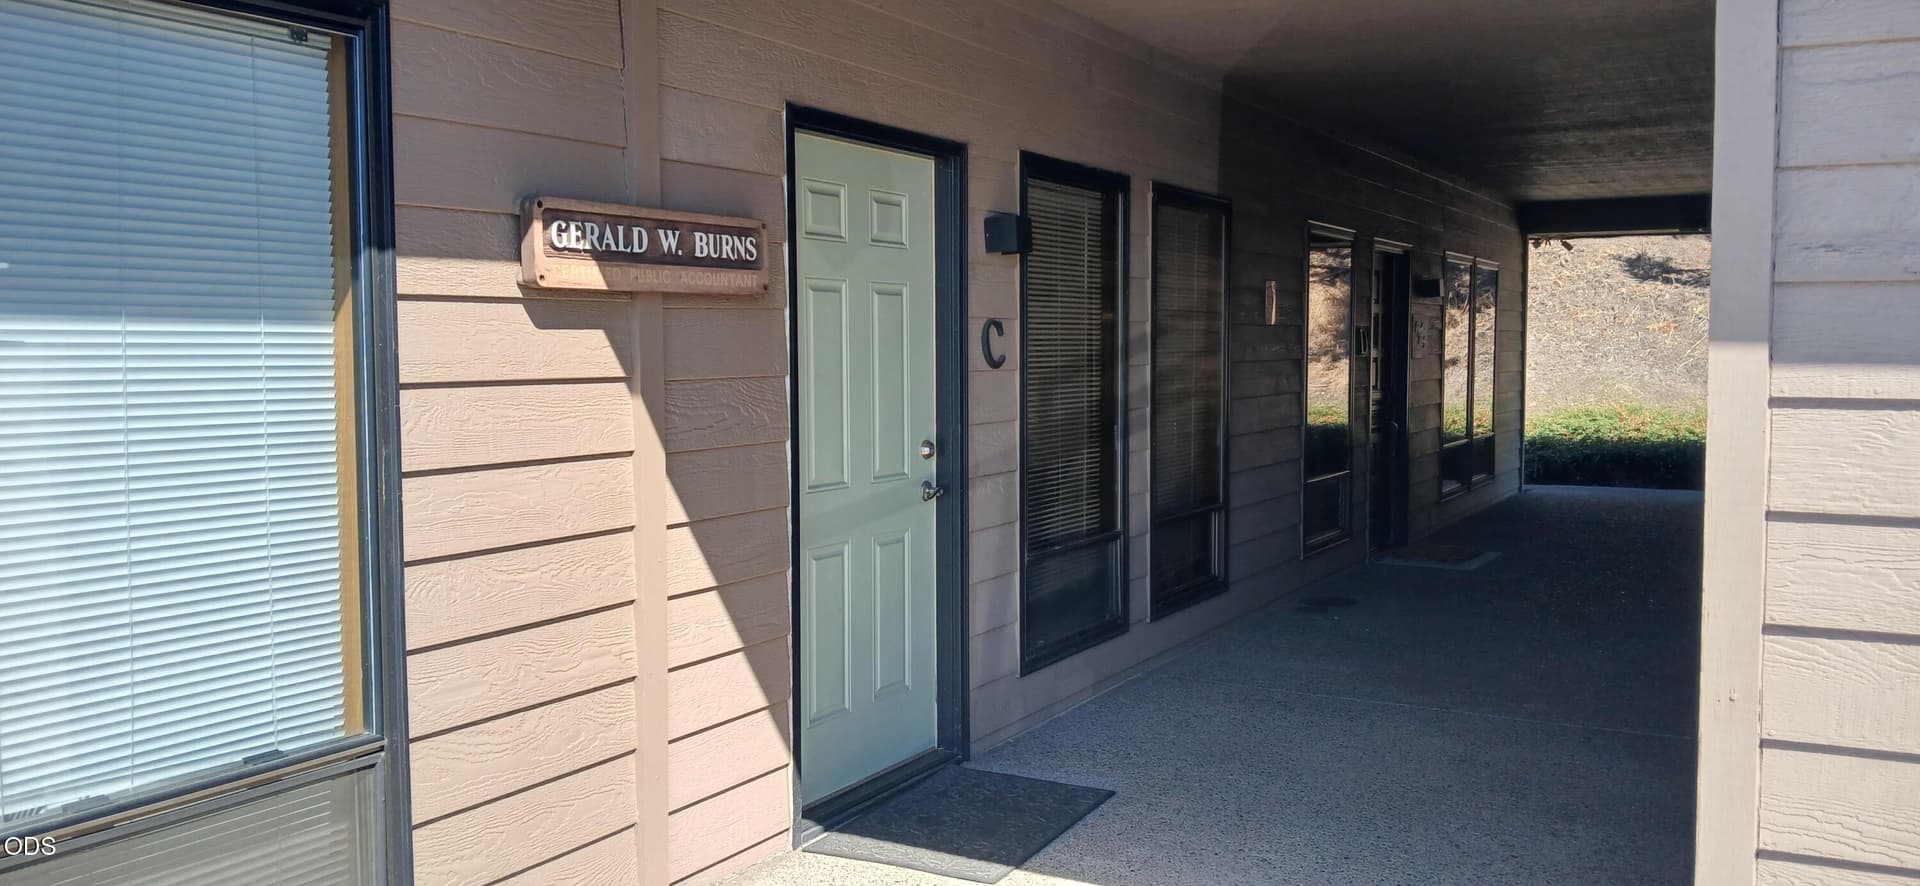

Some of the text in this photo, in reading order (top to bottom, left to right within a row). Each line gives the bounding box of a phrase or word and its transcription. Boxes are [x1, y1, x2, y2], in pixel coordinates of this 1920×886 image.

[551, 220, 758, 261] GERALD W. BURNS
[630, 267, 671, 284] PUBLIC
[680, 271, 758, 288] ACCOUNTANT
[981, 319, 1006, 369] C
